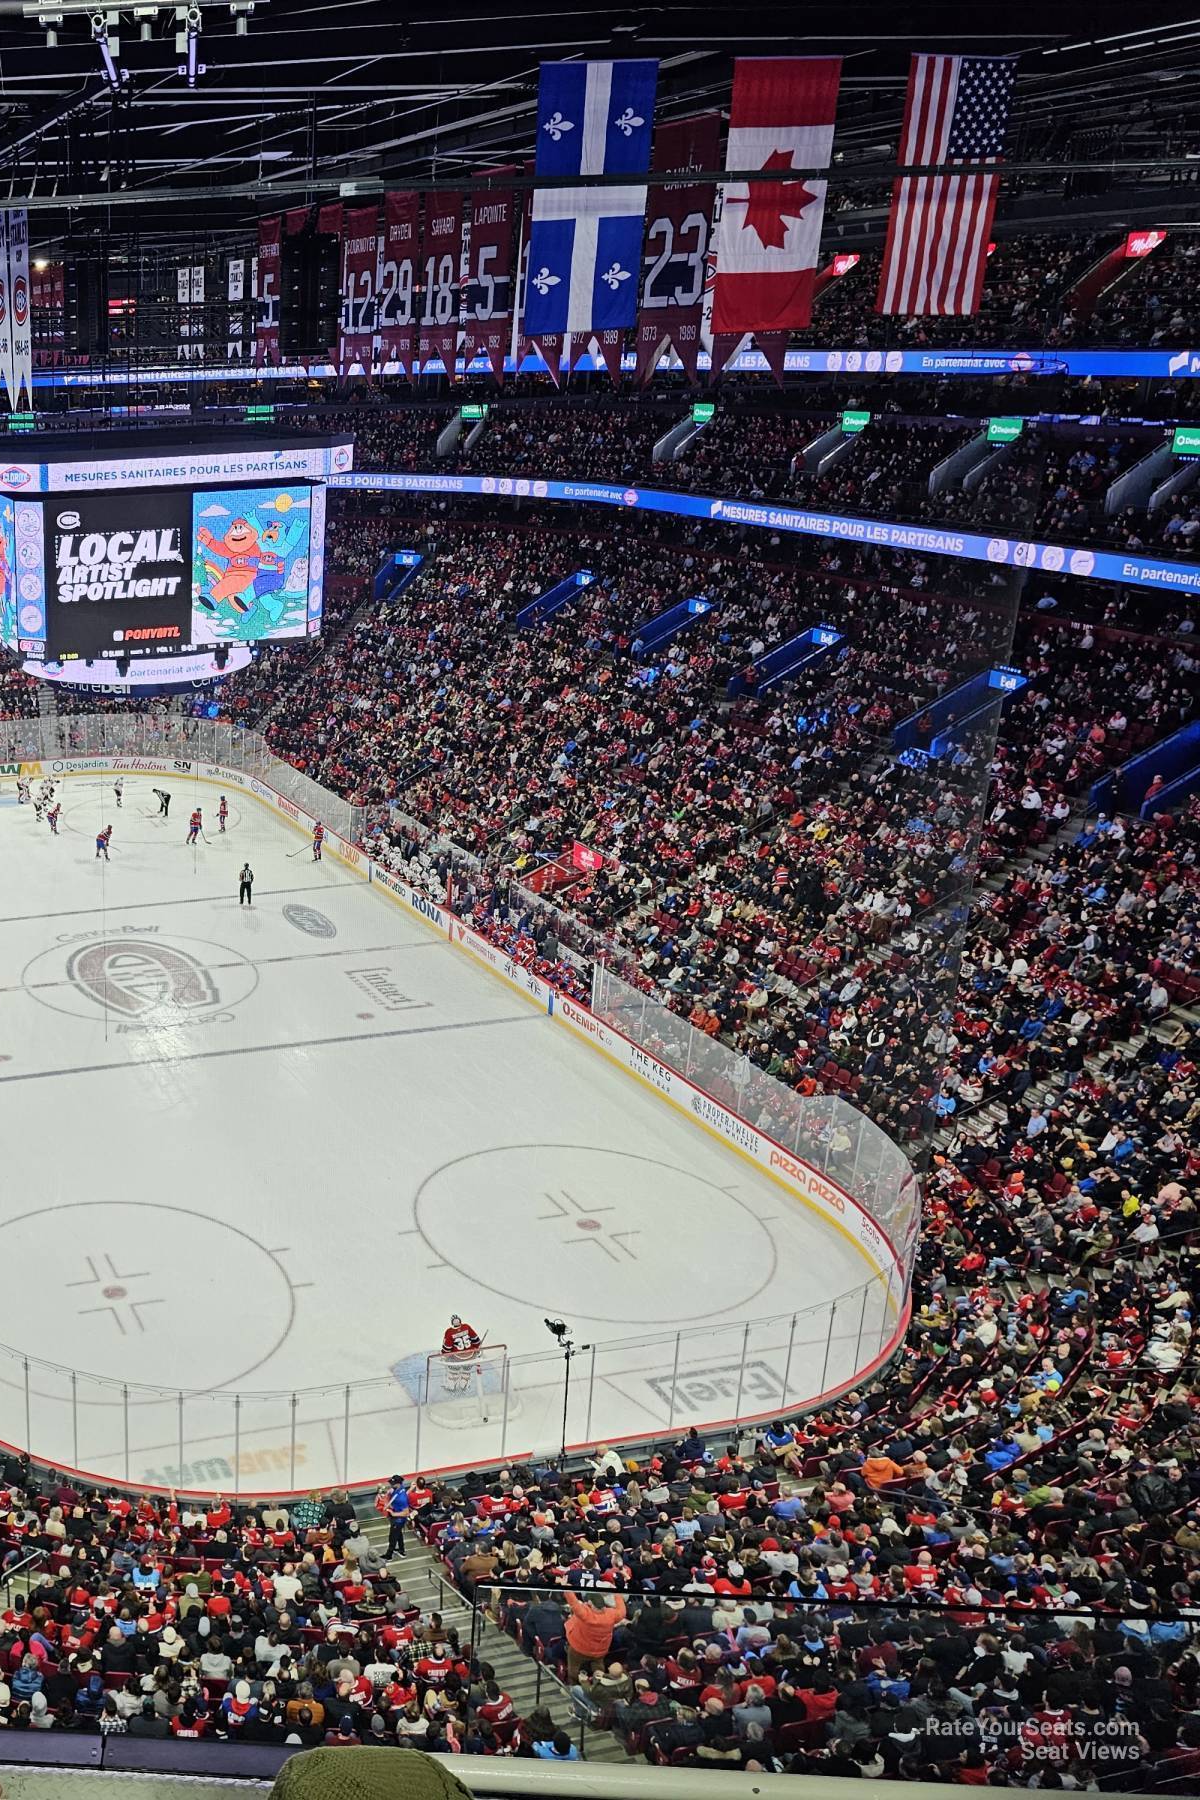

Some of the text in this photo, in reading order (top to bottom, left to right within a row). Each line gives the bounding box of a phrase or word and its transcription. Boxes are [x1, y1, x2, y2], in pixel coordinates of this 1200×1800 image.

[431, 216, 455, 236] SAVARD
[474, 203, 508, 226] LAPOINTE
[390, 222, 412, 241] DRYDEN
[642, 211, 708, 309] 23
[383, 258, 413, 327] 29
[421, 254, 454, 326] 18
[475, 245, 498, 321] 5
[262, 273, 275, 328] 5
[348, 270, 372, 336] 12
[603, 330, 619, 345] 1989
[642, 324, 697, 341] 1973 1989
[922, 356, 933, 366] En
[65, 460, 308, 483] MESURES SANITAIRES POUR LES PARTISANS
[354, 476, 463, 490] POUR LES PARTISANS
[564, 486, 573, 496] En
[609, 491, 622, 500] avec
[722, 504, 964, 552] MESURES SANITAIRES POUR LES PARTISANS
[58, 530, 180, 566] LOCAL
[56, 562, 138, 585] ARTIST
[1122, 563, 1139, 576] En
[58, 576, 181, 603] SPOTLIGHT
[124, 626, 181, 641] PONYMTL
[820, 632, 833, 643] Bell
[130, 662, 207, 678] partenariat avec
[1000, 675, 1017, 690] Bell
[0, 761, 43, 775] WM
[66, 760, 109, 770] Desjardins
[112, 758, 167, 771] Tim Hortons
[173, 760, 192, 771] SN
[411, 892, 444, 927] RONA
[630, 1046, 672, 1082] THE KEG
[702, 1100, 759, 1148] PROPER TWELVE
[702, 1112, 758, 1153] IRISH WHISKEY
[770, 1150, 846, 1215] pizza pizza
[861, 1216, 880, 1245] Scotia
[453, 1334, 472, 1351] 35
[670, 1373, 782, 1411] Fuel
